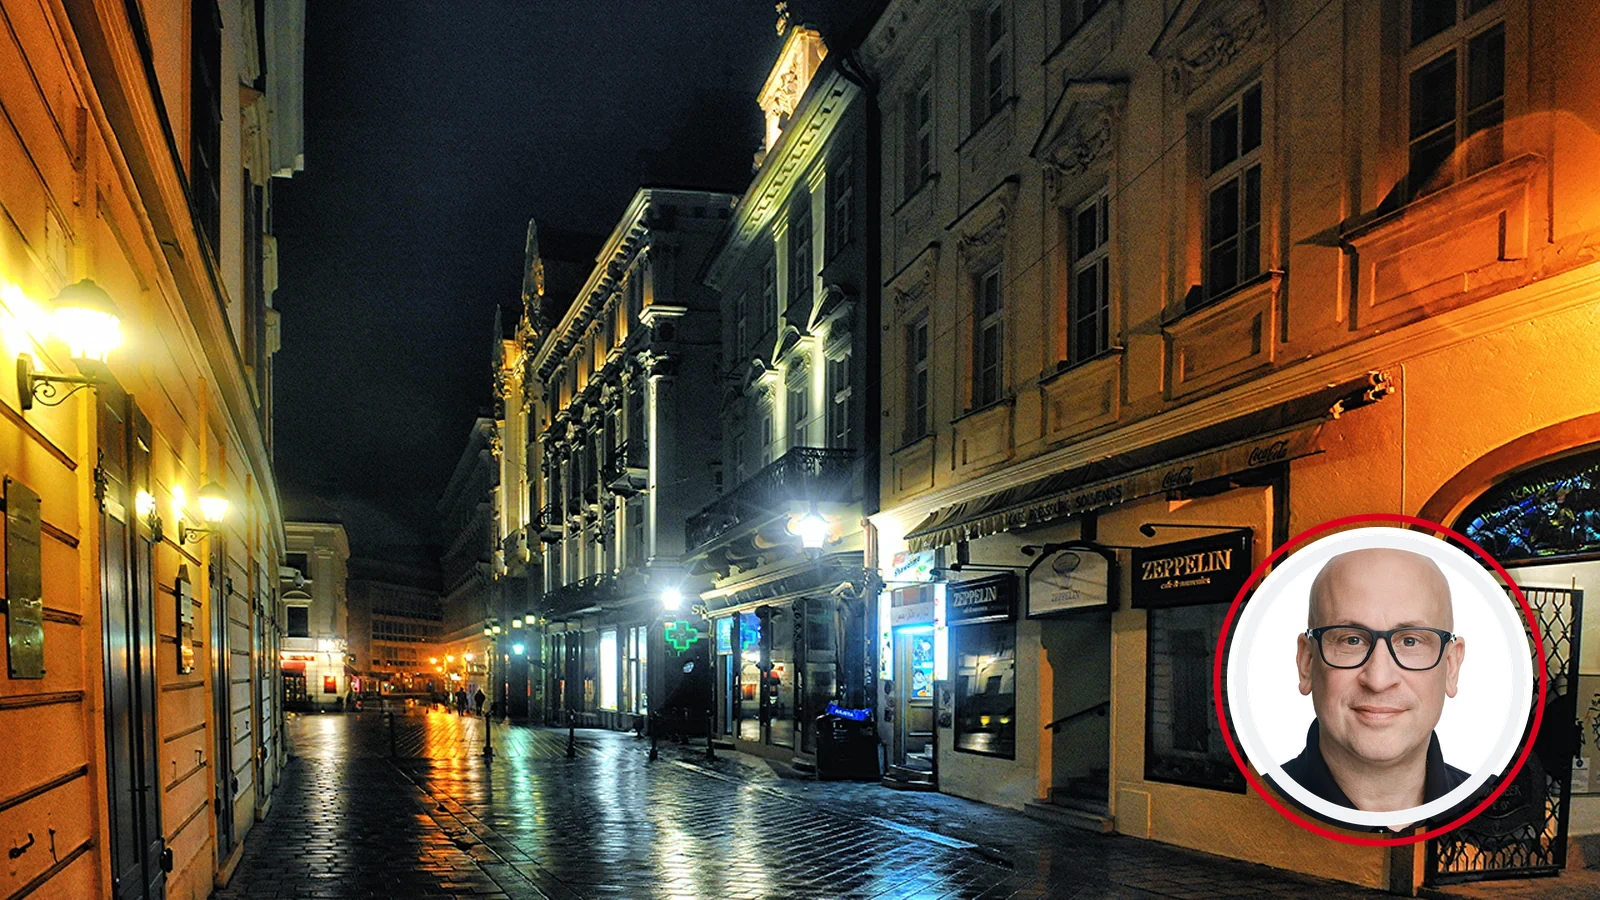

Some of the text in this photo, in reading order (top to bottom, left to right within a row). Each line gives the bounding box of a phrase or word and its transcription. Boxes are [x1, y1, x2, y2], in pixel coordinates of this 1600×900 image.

[1249, 440, 1289, 465] Coca-Cola
[1142, 548, 1233, 581] ZEPPELIN
[953, 585, 997, 607] ZEPPELIN
